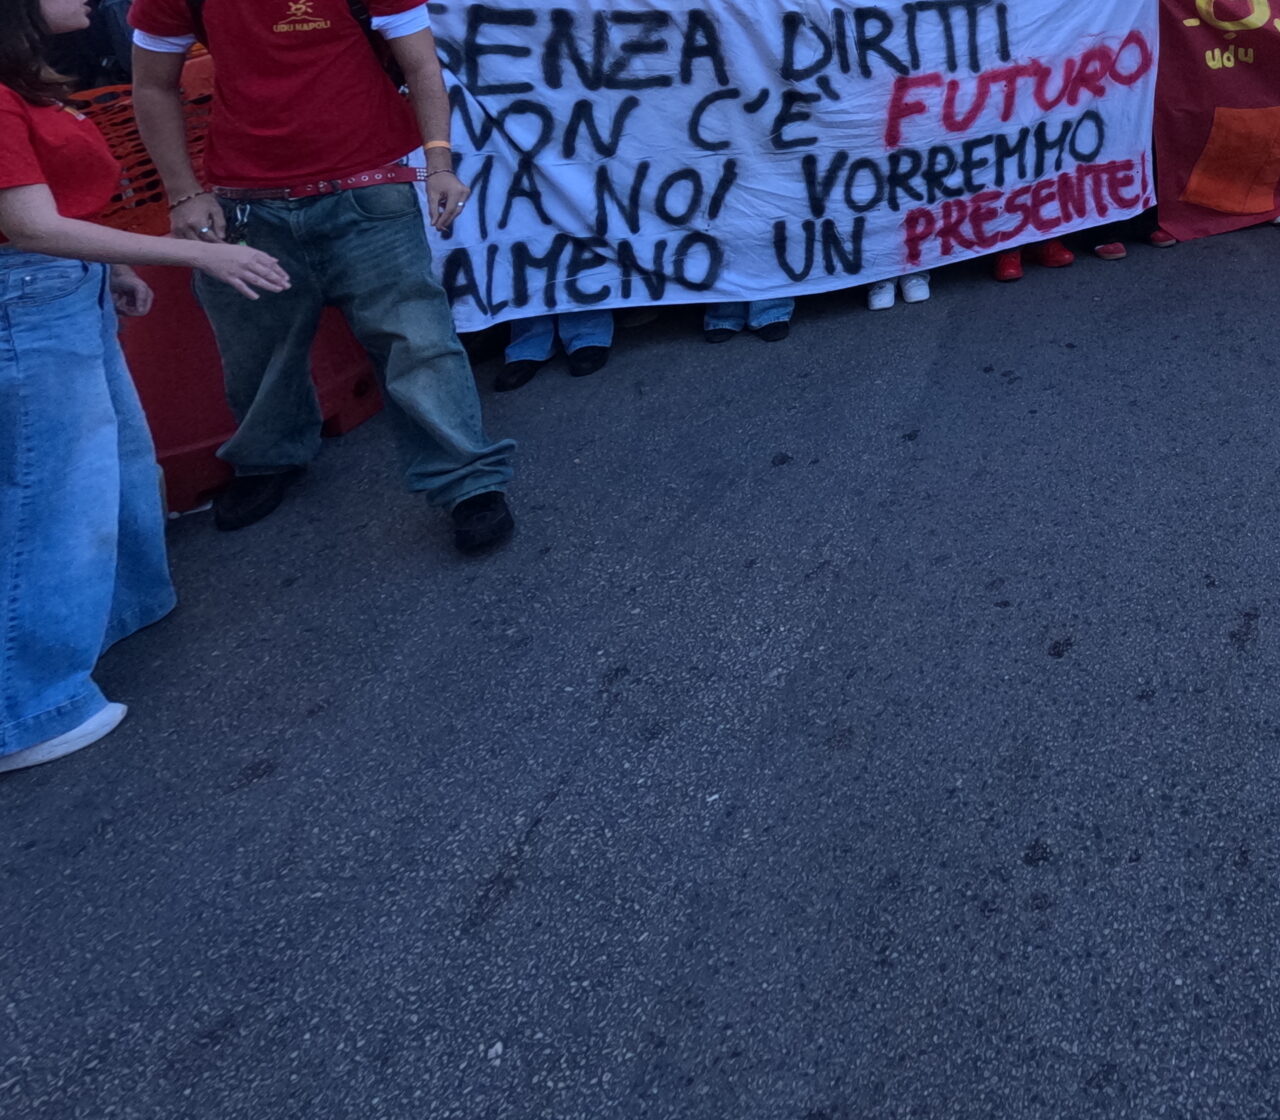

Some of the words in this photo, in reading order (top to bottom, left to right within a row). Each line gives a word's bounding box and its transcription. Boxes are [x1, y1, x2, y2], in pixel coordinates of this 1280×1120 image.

[295, 20, 331, 31] NAPOLI
[1205, 44, 1255, 70] udu
[449, 84, 640, 159] NON
[883, 28, 1153, 148] FUTURO
[442, 230, 724, 316] ALMENO
[773, 215, 865, 282] UN
[903, 153, 1154, 267] PRESENTE!
[595, 158, 738, 237] NOI
[802, 109, 1105, 218] VORREMMO
